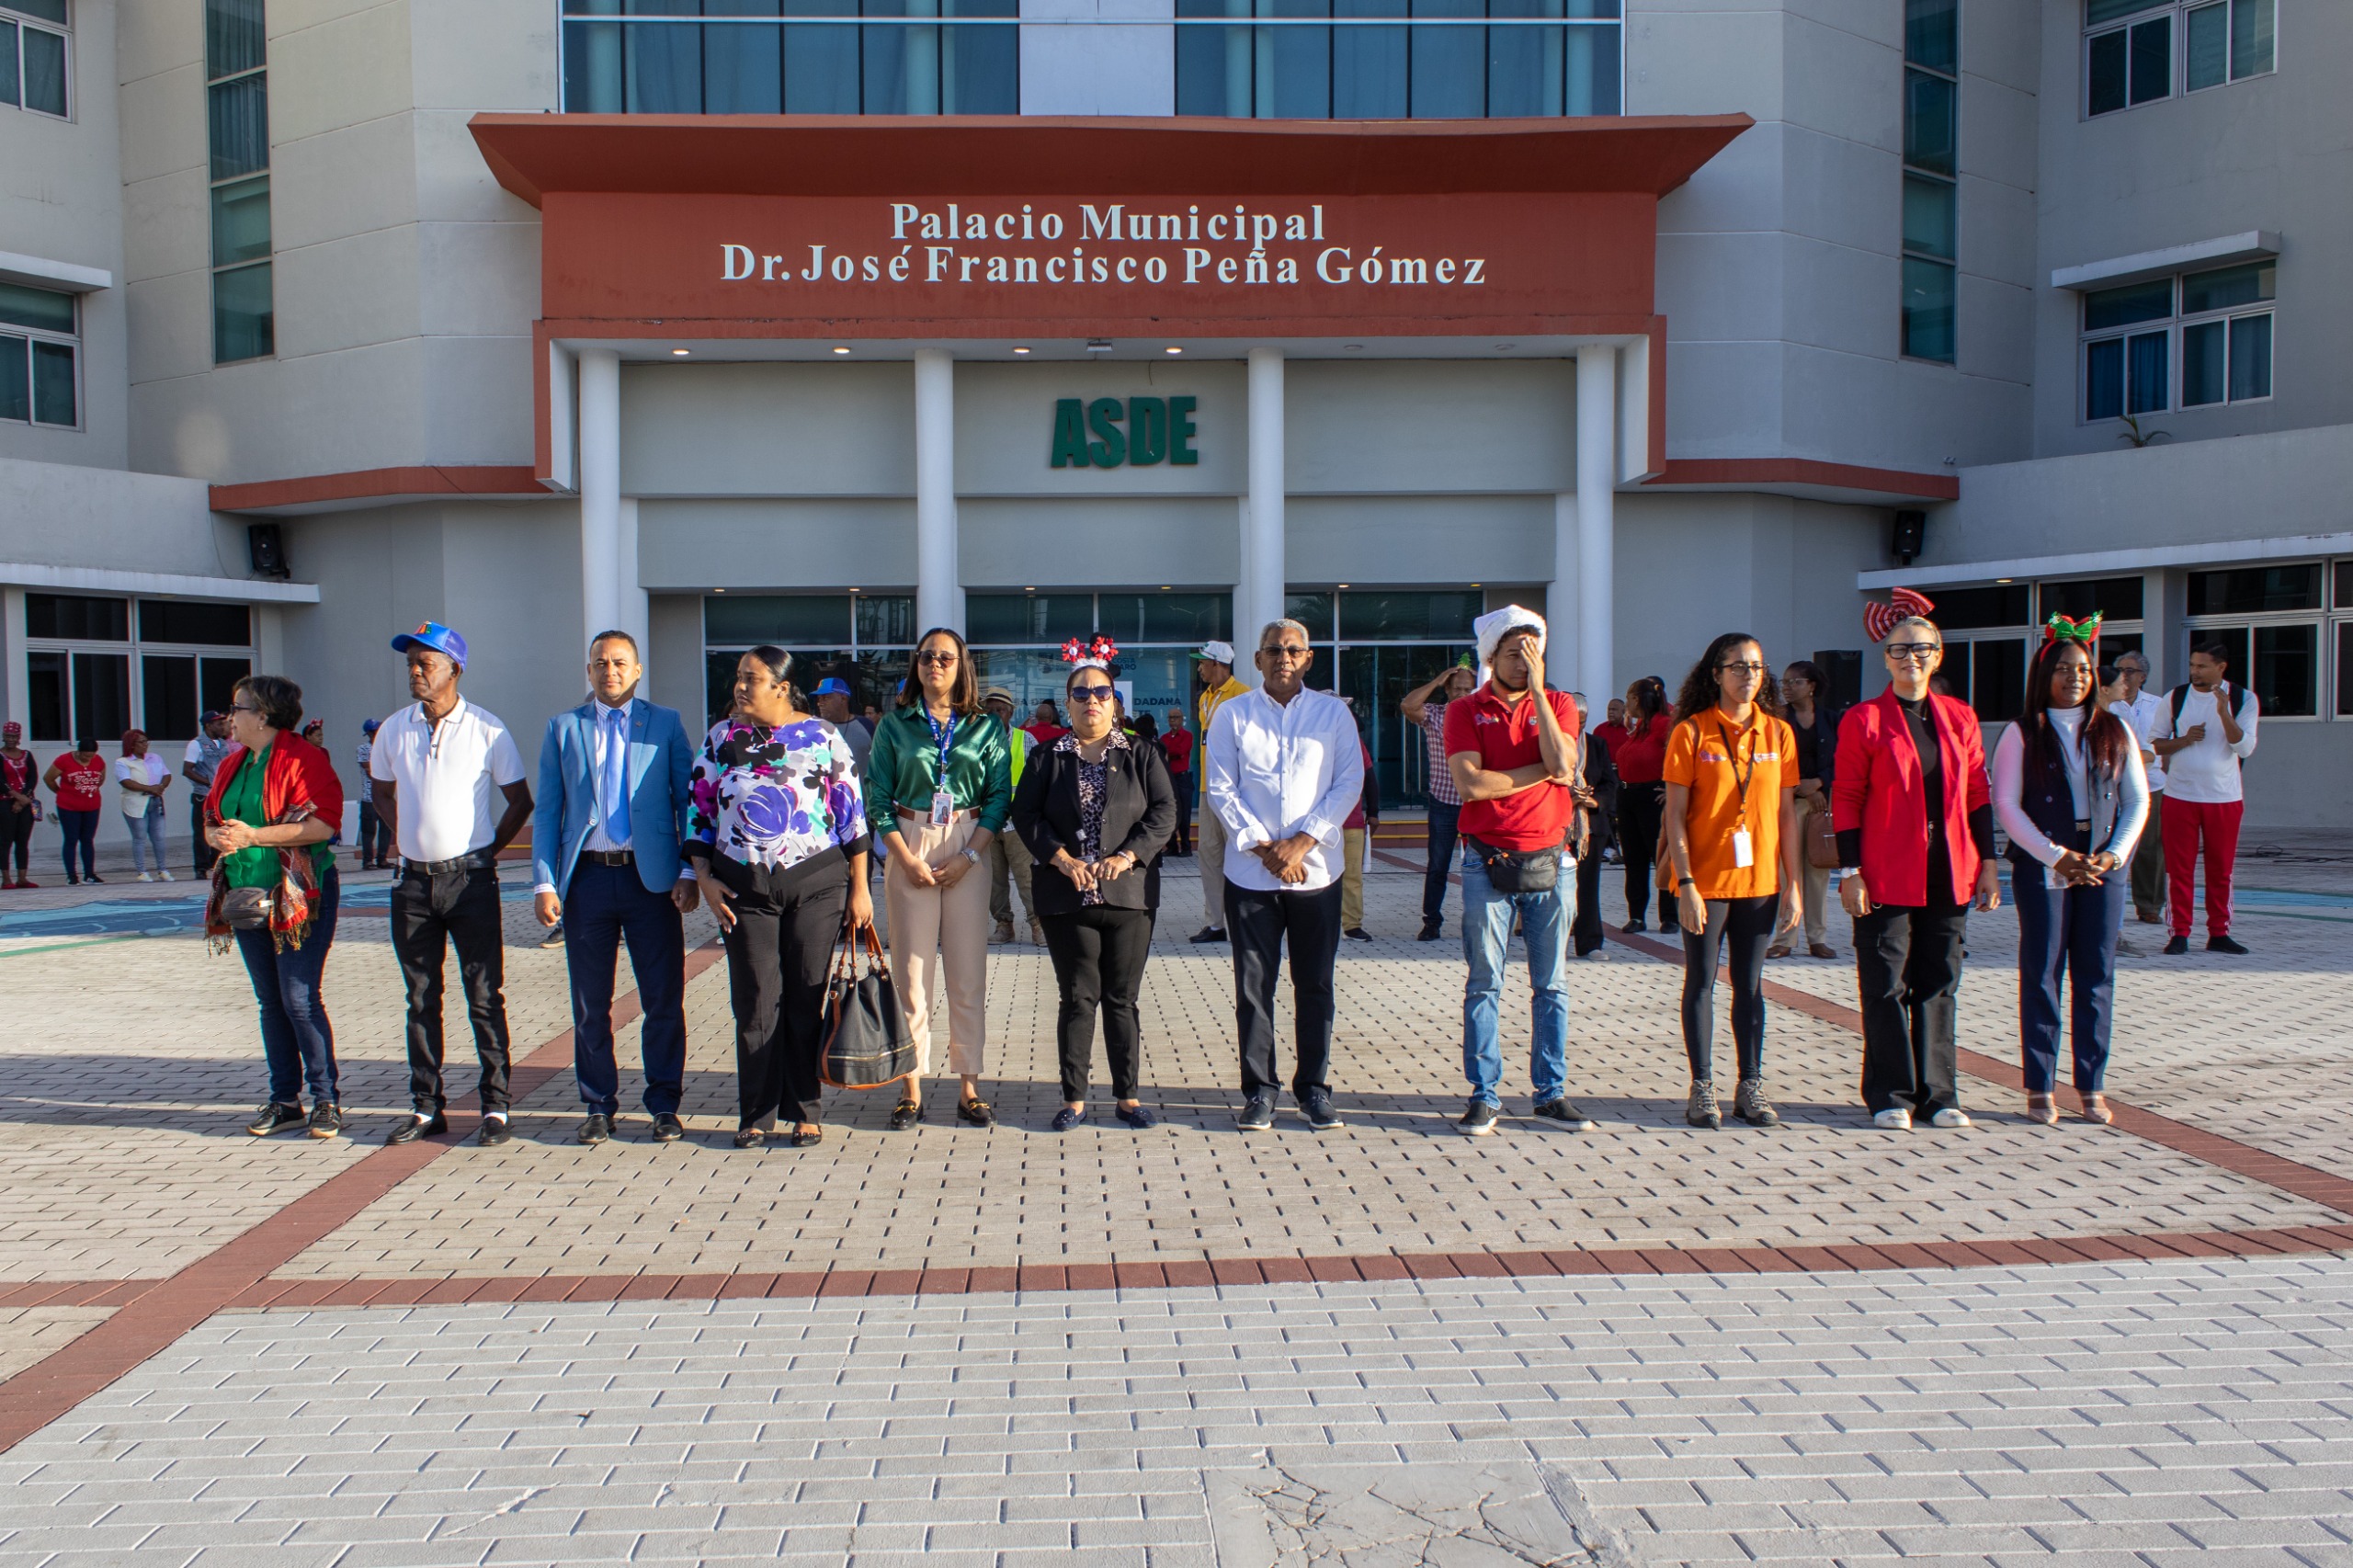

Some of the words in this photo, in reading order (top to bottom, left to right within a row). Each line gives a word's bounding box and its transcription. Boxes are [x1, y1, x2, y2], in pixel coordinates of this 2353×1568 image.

[891, 204, 1063, 240] Palacio
[1080, 205, 1324, 251] Municipal
[721, 244, 790, 280] Dr.
[801, 245, 913, 282] José
[925, 247, 1167, 283] Francisco
[1183, 248, 1300, 284] Peña
[1316, 247, 1485, 284] Gómez
[1050, 395, 1199, 469] ASDE
[1133, 697, 1182, 706] DADANA
